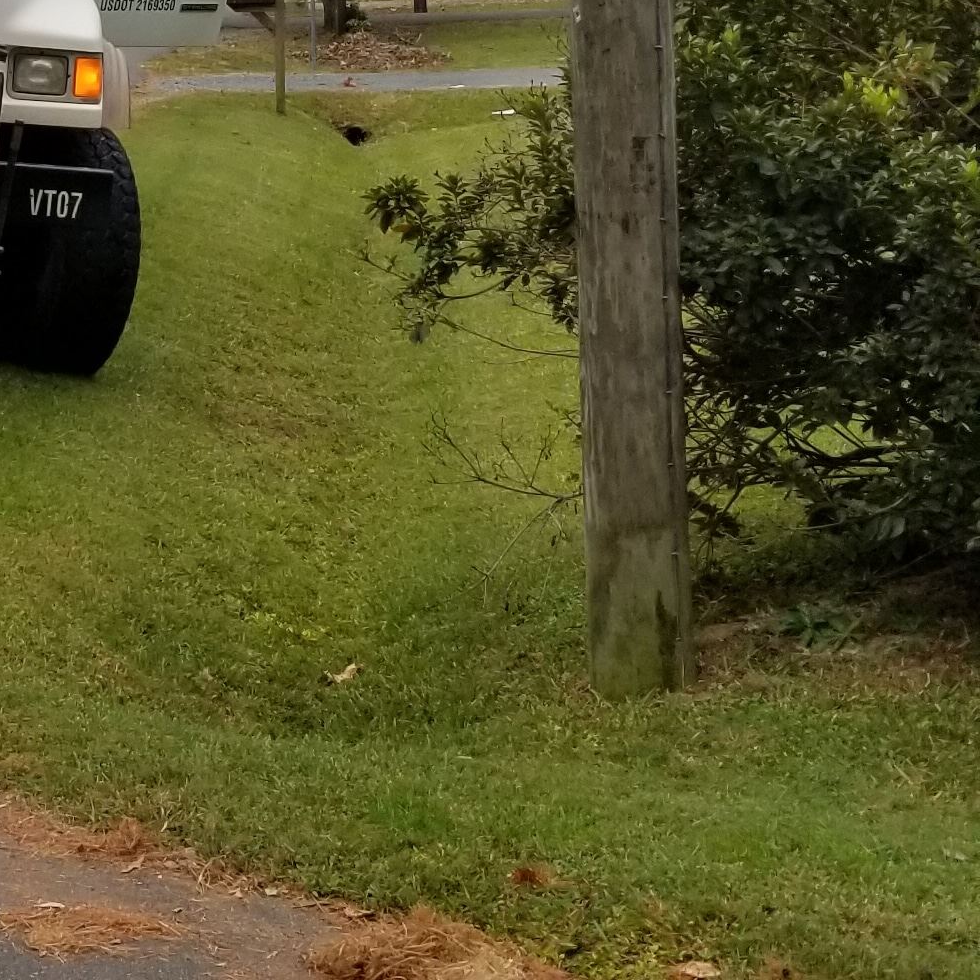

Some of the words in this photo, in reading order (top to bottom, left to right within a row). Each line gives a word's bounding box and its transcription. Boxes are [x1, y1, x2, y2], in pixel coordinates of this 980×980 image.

[100, 0, 135, 12] USDOT
[135, 0, 176, 12] 2169350
[29, 188, 83, 219] VT07
